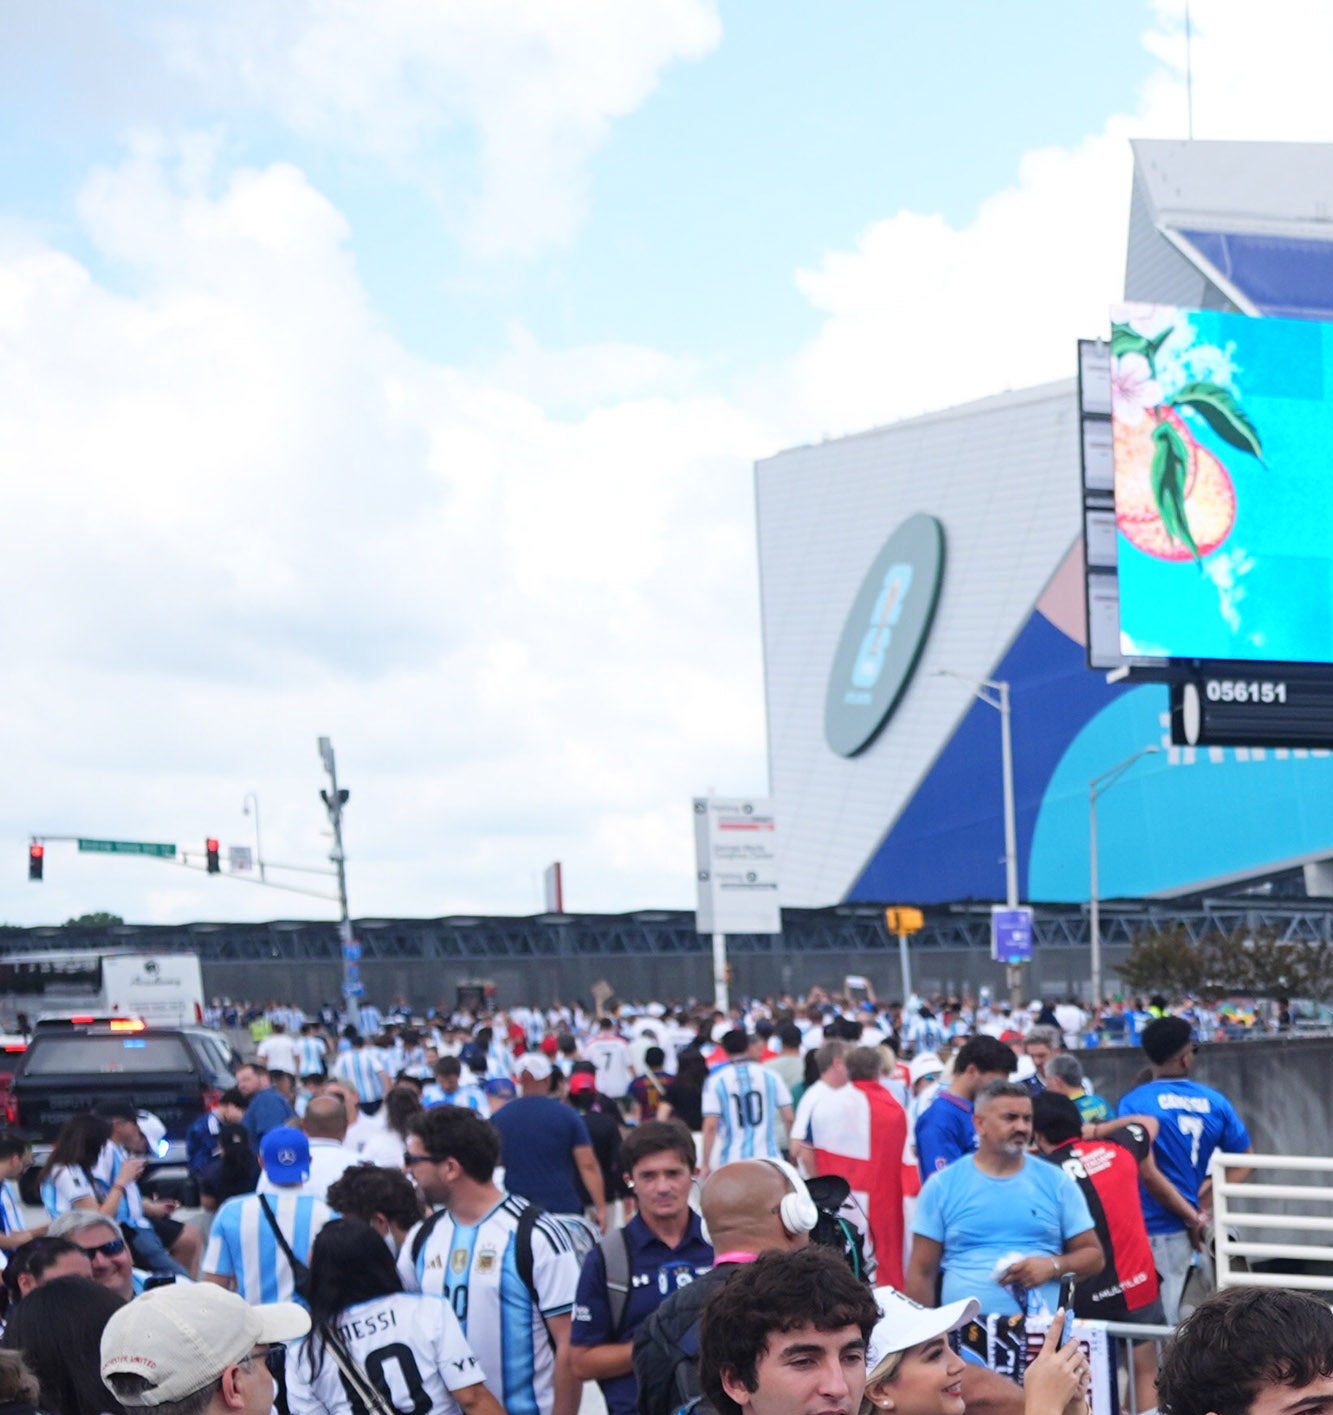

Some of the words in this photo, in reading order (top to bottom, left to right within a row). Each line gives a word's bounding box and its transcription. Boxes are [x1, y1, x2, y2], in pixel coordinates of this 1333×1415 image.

[1206, 680, 1286, 703] 056151
[730, 1090, 763, 1127] 10
[1178, 1114, 1204, 1169] 7
